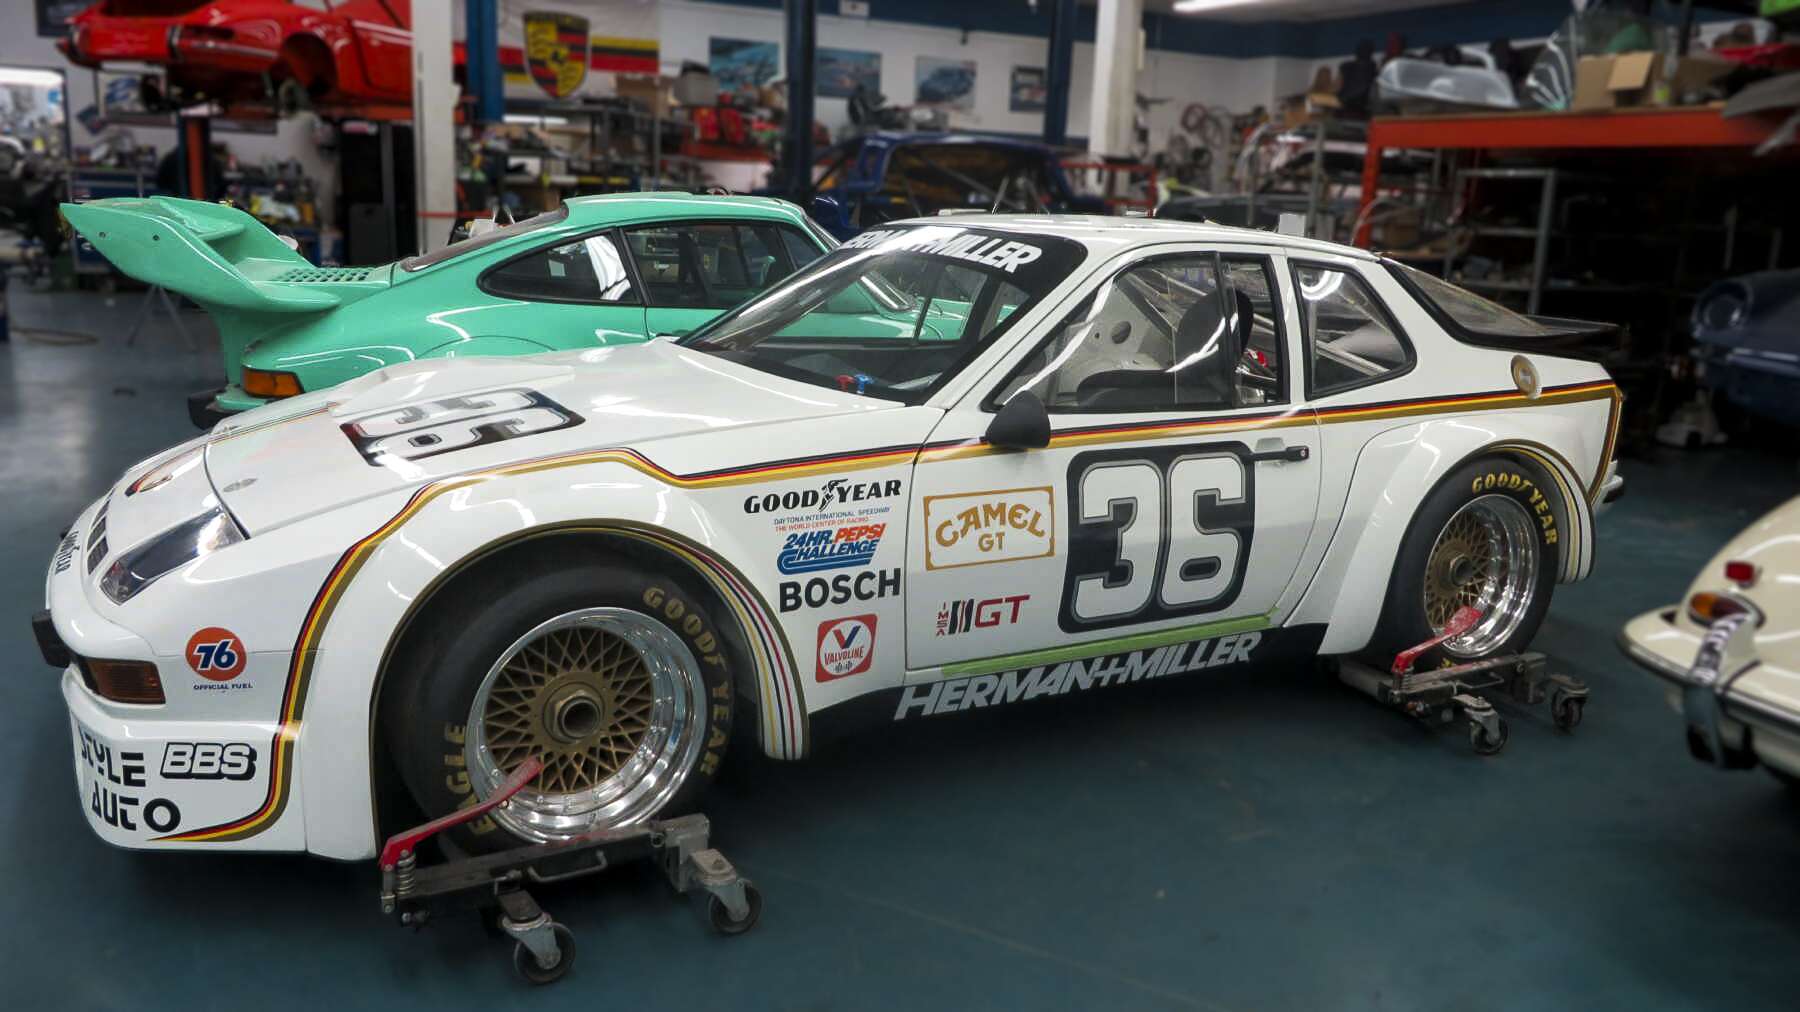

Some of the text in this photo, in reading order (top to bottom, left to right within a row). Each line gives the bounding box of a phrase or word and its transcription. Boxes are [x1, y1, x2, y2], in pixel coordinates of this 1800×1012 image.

[805, 510, 855, 522] INTERNATIONAL
[833, 523, 887, 545] PEPSI
[935, 502, 1046, 548] CAMEL
[777, 538, 881, 575] CHALLENGE
[978, 532, 1005, 552] GT
[1070, 451, 1248, 625] 36
[779, 567, 901, 613] BOSCH
[936, 594, 1031, 636] IMSA GT
[193, 639, 239, 671] 76
[824, 646, 865, 666] VALVOLINE
[193, 682, 253, 691] OFFICIAL FUEL
[160, 741, 257, 781] BBS
[91, 779, 182, 834] AUTO
